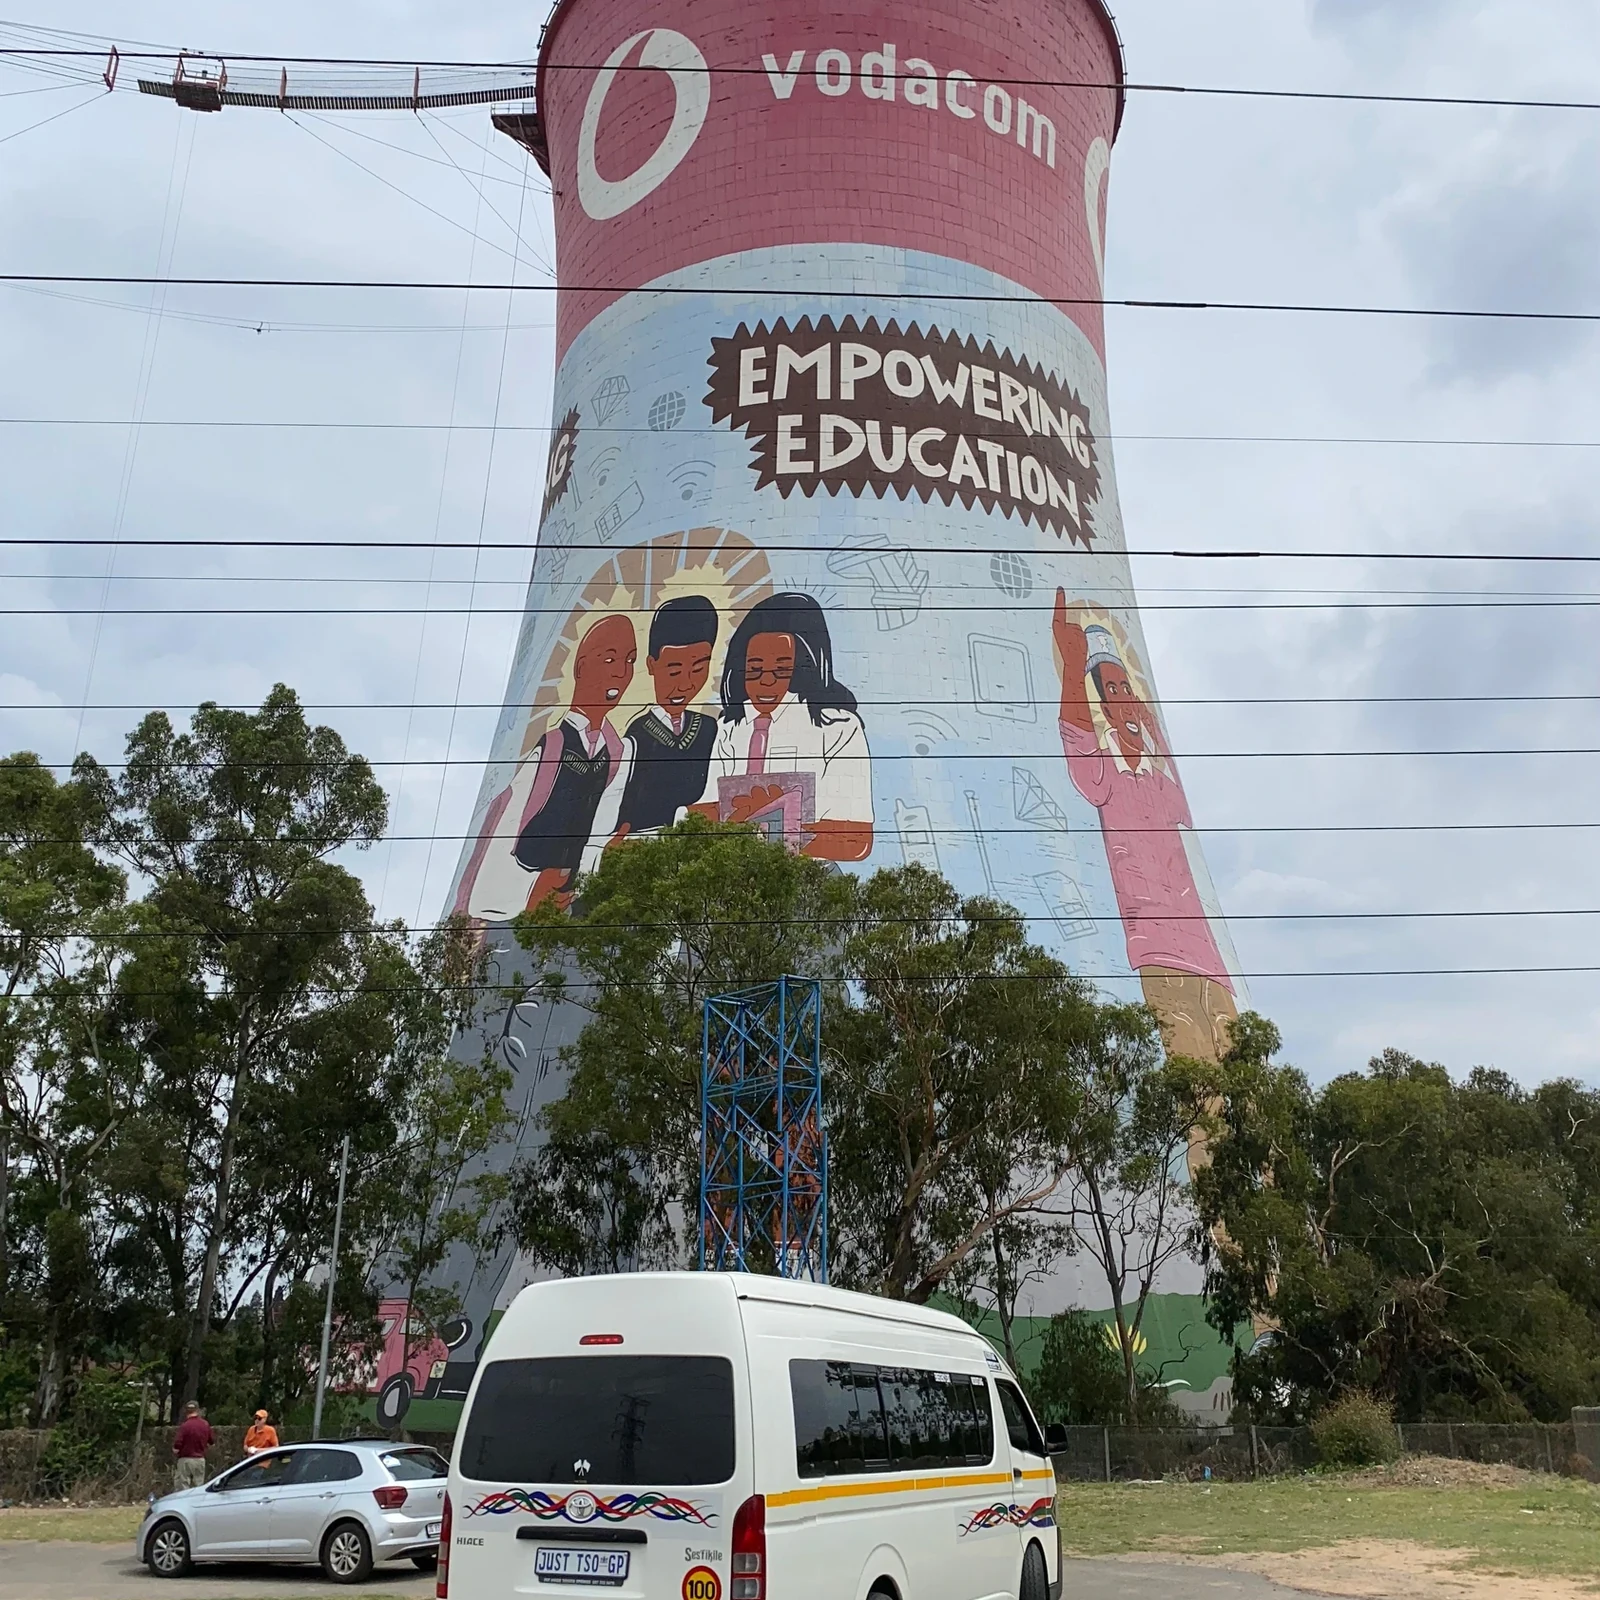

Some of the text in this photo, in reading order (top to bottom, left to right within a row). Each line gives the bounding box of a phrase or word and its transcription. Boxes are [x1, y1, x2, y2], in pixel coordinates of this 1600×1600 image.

[761, 43, 1056, 169] vodacom
[738, 342, 1090, 469] EMPOWERING
[775, 414, 1082, 528] EDUCATION
[456, 1537, 485, 1546] HIACE
[538, 1552, 570, 1571] JUST
[608, 1554, 625, 1574] GP
[687, 1579, 716, 1600] 100
